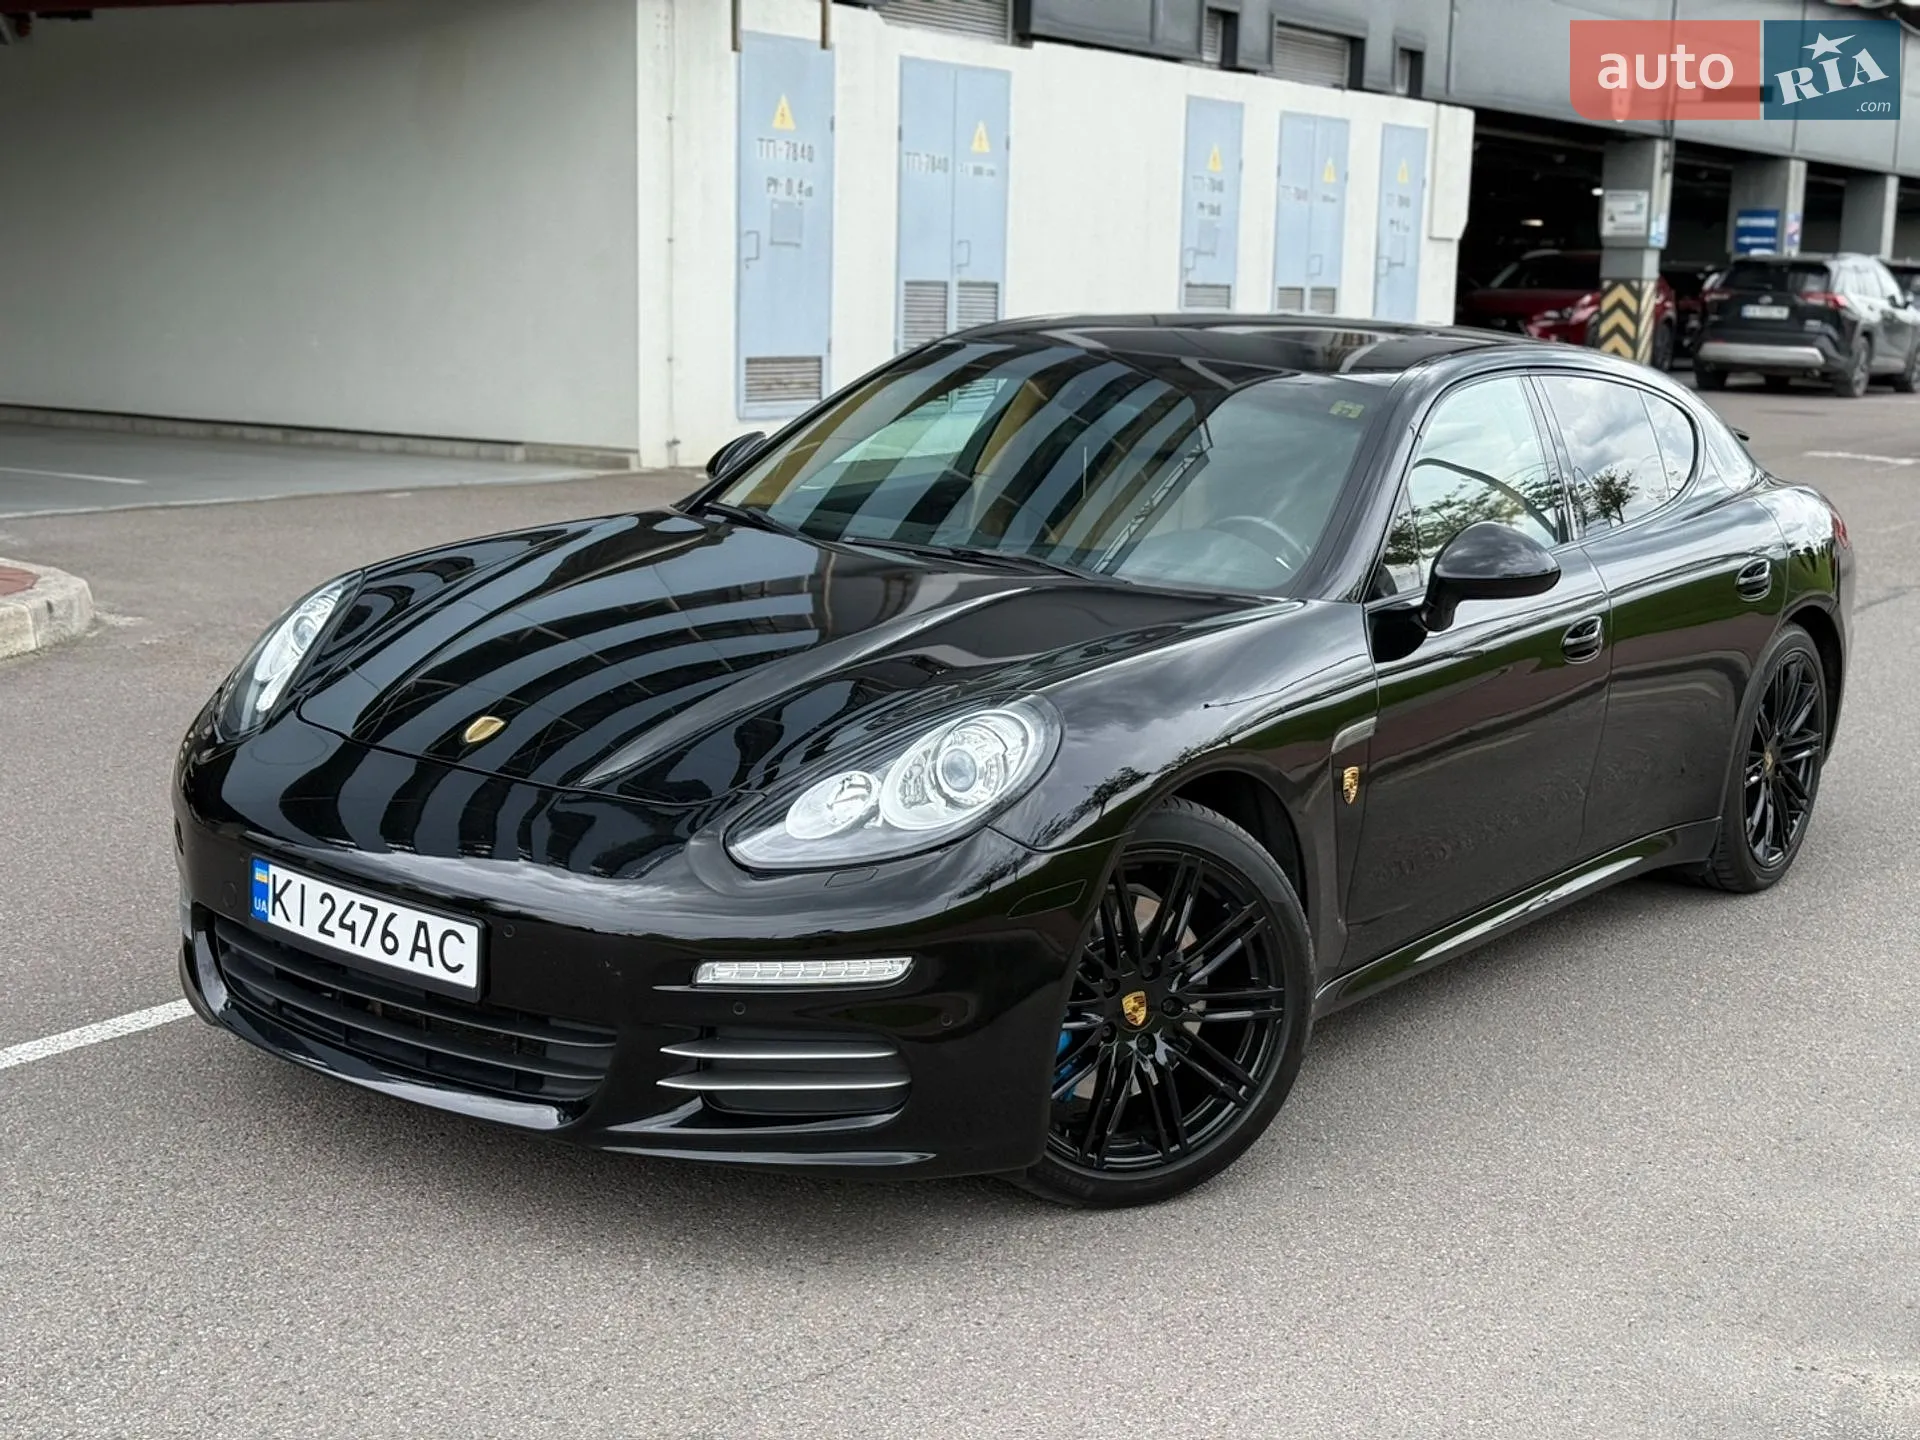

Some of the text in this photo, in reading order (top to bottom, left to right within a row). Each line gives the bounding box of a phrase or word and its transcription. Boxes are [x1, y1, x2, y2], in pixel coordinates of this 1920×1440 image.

[254, 895, 269, 914] UA
[271, 873, 466, 974] KI 2476 AC
